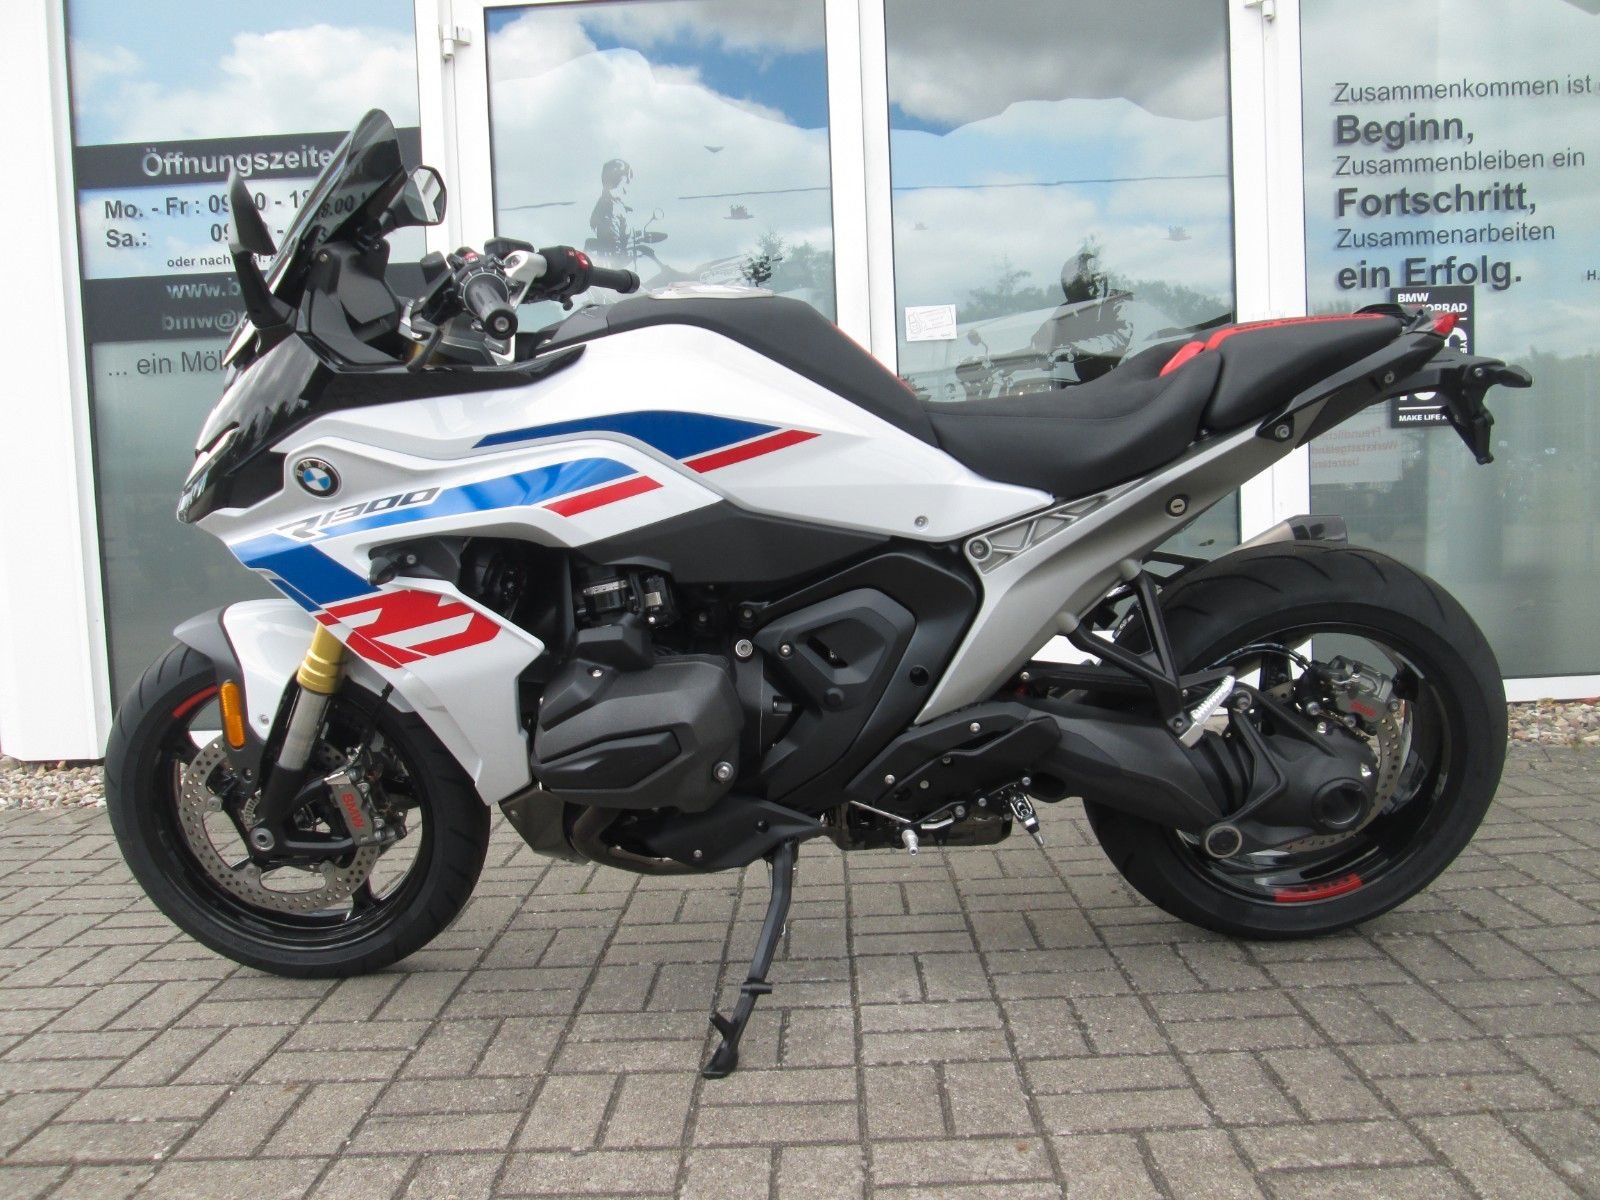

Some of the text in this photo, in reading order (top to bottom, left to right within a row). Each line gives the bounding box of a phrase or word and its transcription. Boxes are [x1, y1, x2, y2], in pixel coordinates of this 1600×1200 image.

[1334, 77, 1559, 102] Zusammenkommen
[1567, 74, 1592, 95] ist
[1336, 112, 1475, 151] Beginn,
[142, 144, 337, 177] Öffnungszeite
[1335, 147, 1586, 176] Zusammenbleiben ein
[104, 200, 144, 219] Mo.
[1337, 182, 1537, 218] Fortschritt,
[106, 228, 148, 248] Sa.:
[1336, 222, 1556, 249] Zusammenarbeiten
[167, 257, 196, 268] oder
[200, 254, 231, 266] nach
[1338, 255, 1522, 291] ein Erfolg.
[1397, 292, 1430, 303] BMW
[136, 353, 172, 375] ein
[181, 349, 230, 373] Möl
[1398, 414, 1423, 422] MAKE
[1423, 413, 1441, 421] LIFE
[341, 792, 366, 830] BMW
